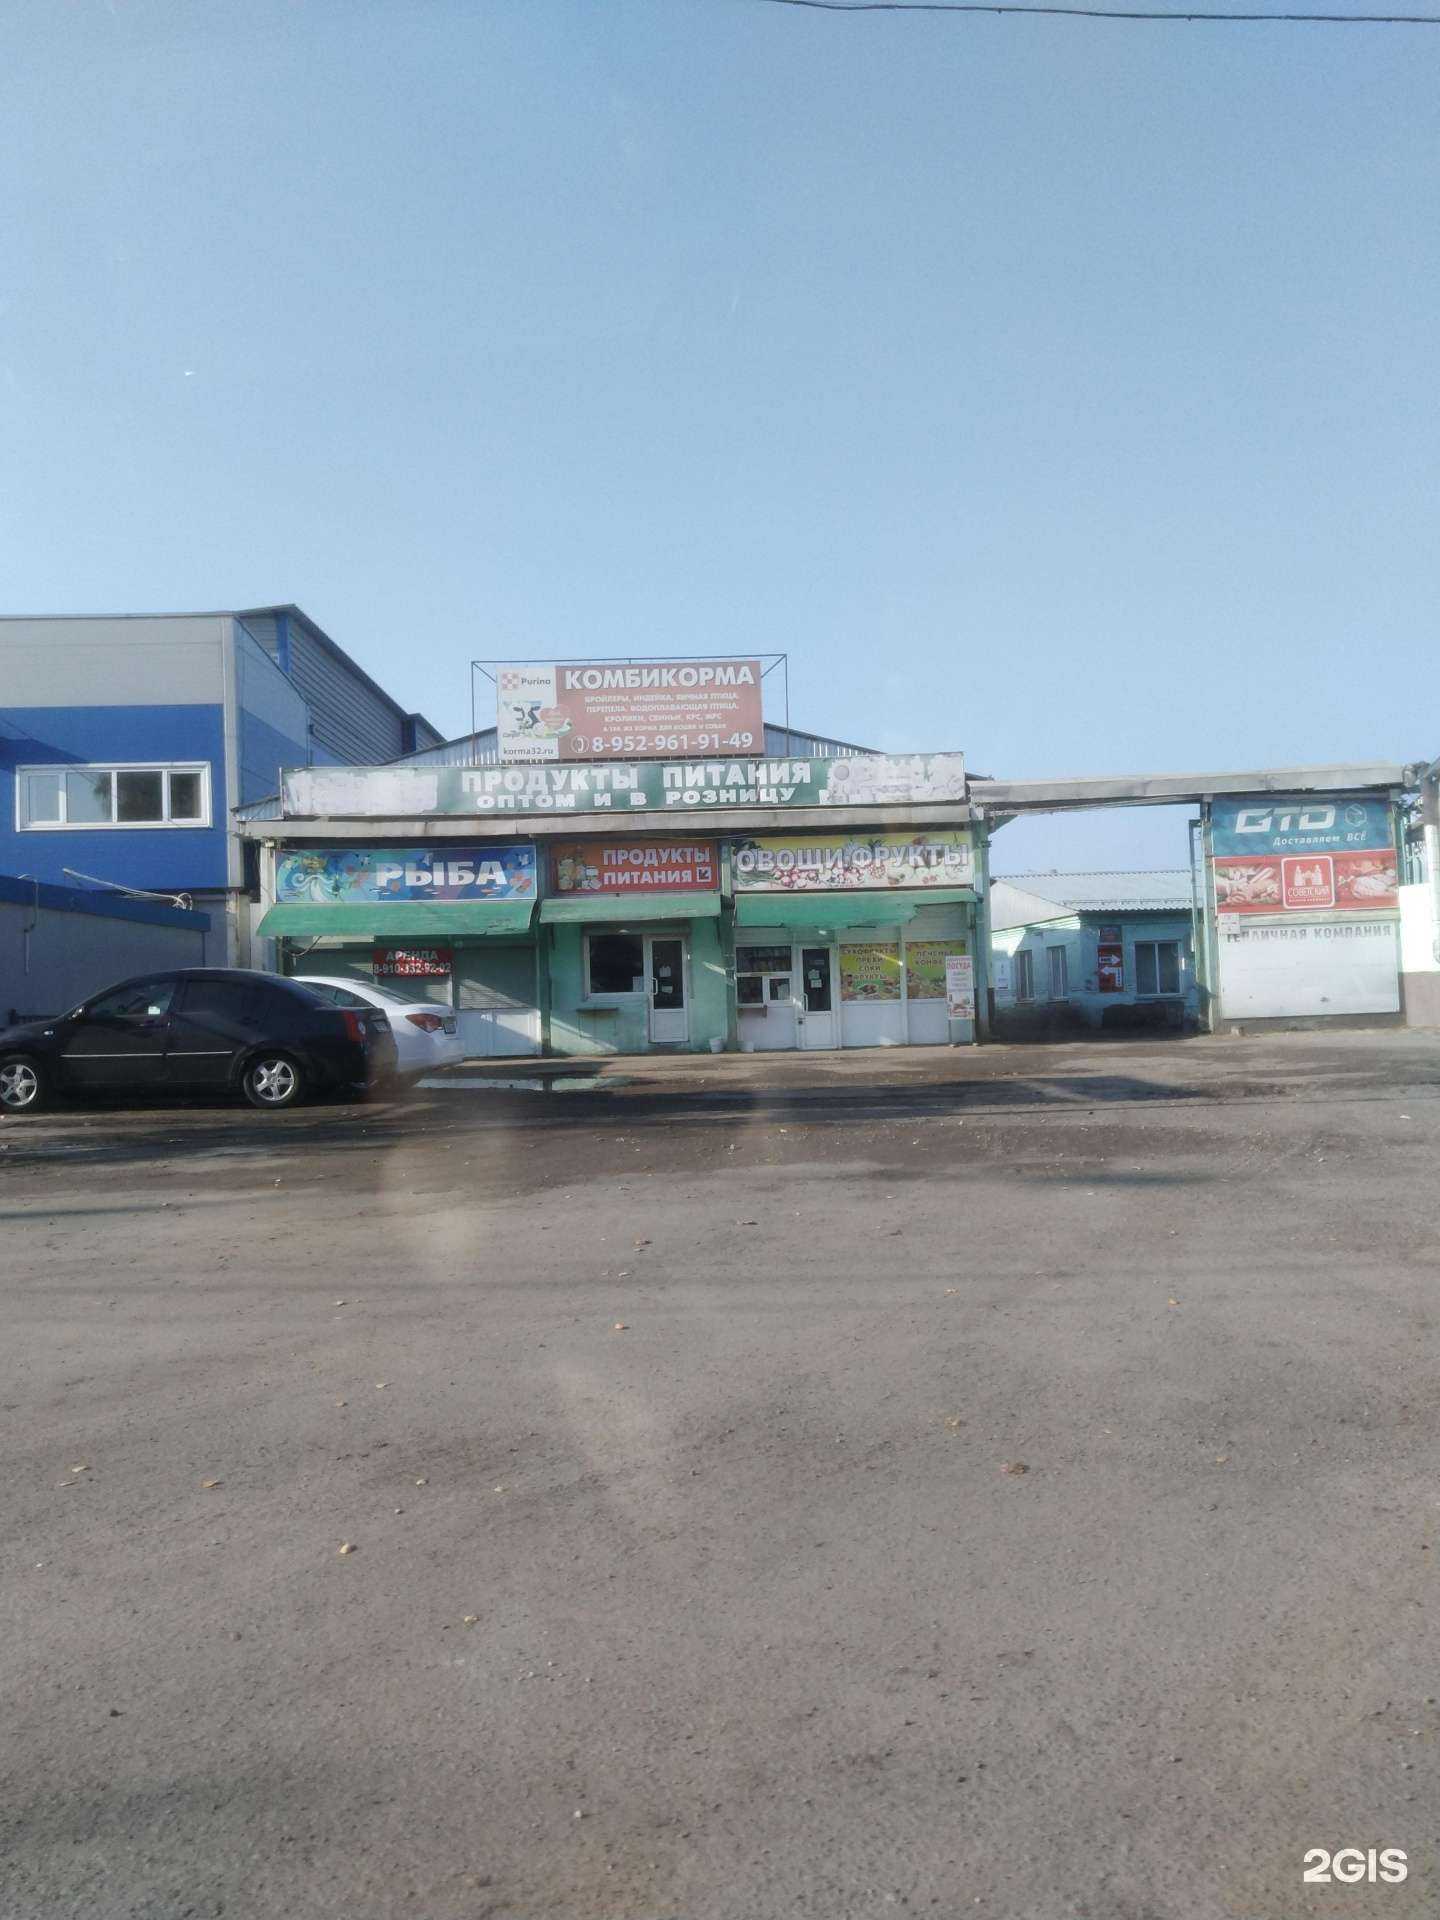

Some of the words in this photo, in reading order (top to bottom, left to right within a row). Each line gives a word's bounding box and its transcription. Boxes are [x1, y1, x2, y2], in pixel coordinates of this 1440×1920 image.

[565, 666, 756, 690] КОМБИКОРМА
[503, 747, 554, 755] korma32.ru
[592, 732, 753, 752] 8-952-961-91-49
[462, 767, 638, 793] ПРОДУКТЫ
[662, 762, 811, 787] ПИТАНИЯ
[476, 794, 576, 808] ОПТОМ
[594, 792, 612, 807] И
[630, 791, 648, 806] В
[666, 787, 796, 804] РОЗНИЦУ
[1235, 805, 1336, 833] GTD
[1273, 836, 1341, 848] Доставляем
[602, 847, 710, 867] ПРОДУКТЫ
[736, 847, 844, 872] ОВОЩИ
[849, 843, 968, 867] ФРУКТЫ
[375, 861, 507, 887] РЫБА
[604, 870, 693, 885] ПИТАНИЯ
[1314, 924, 1392, 939] КОМПАНИЯ
[386, 950, 439, 961] АРЕНДА
